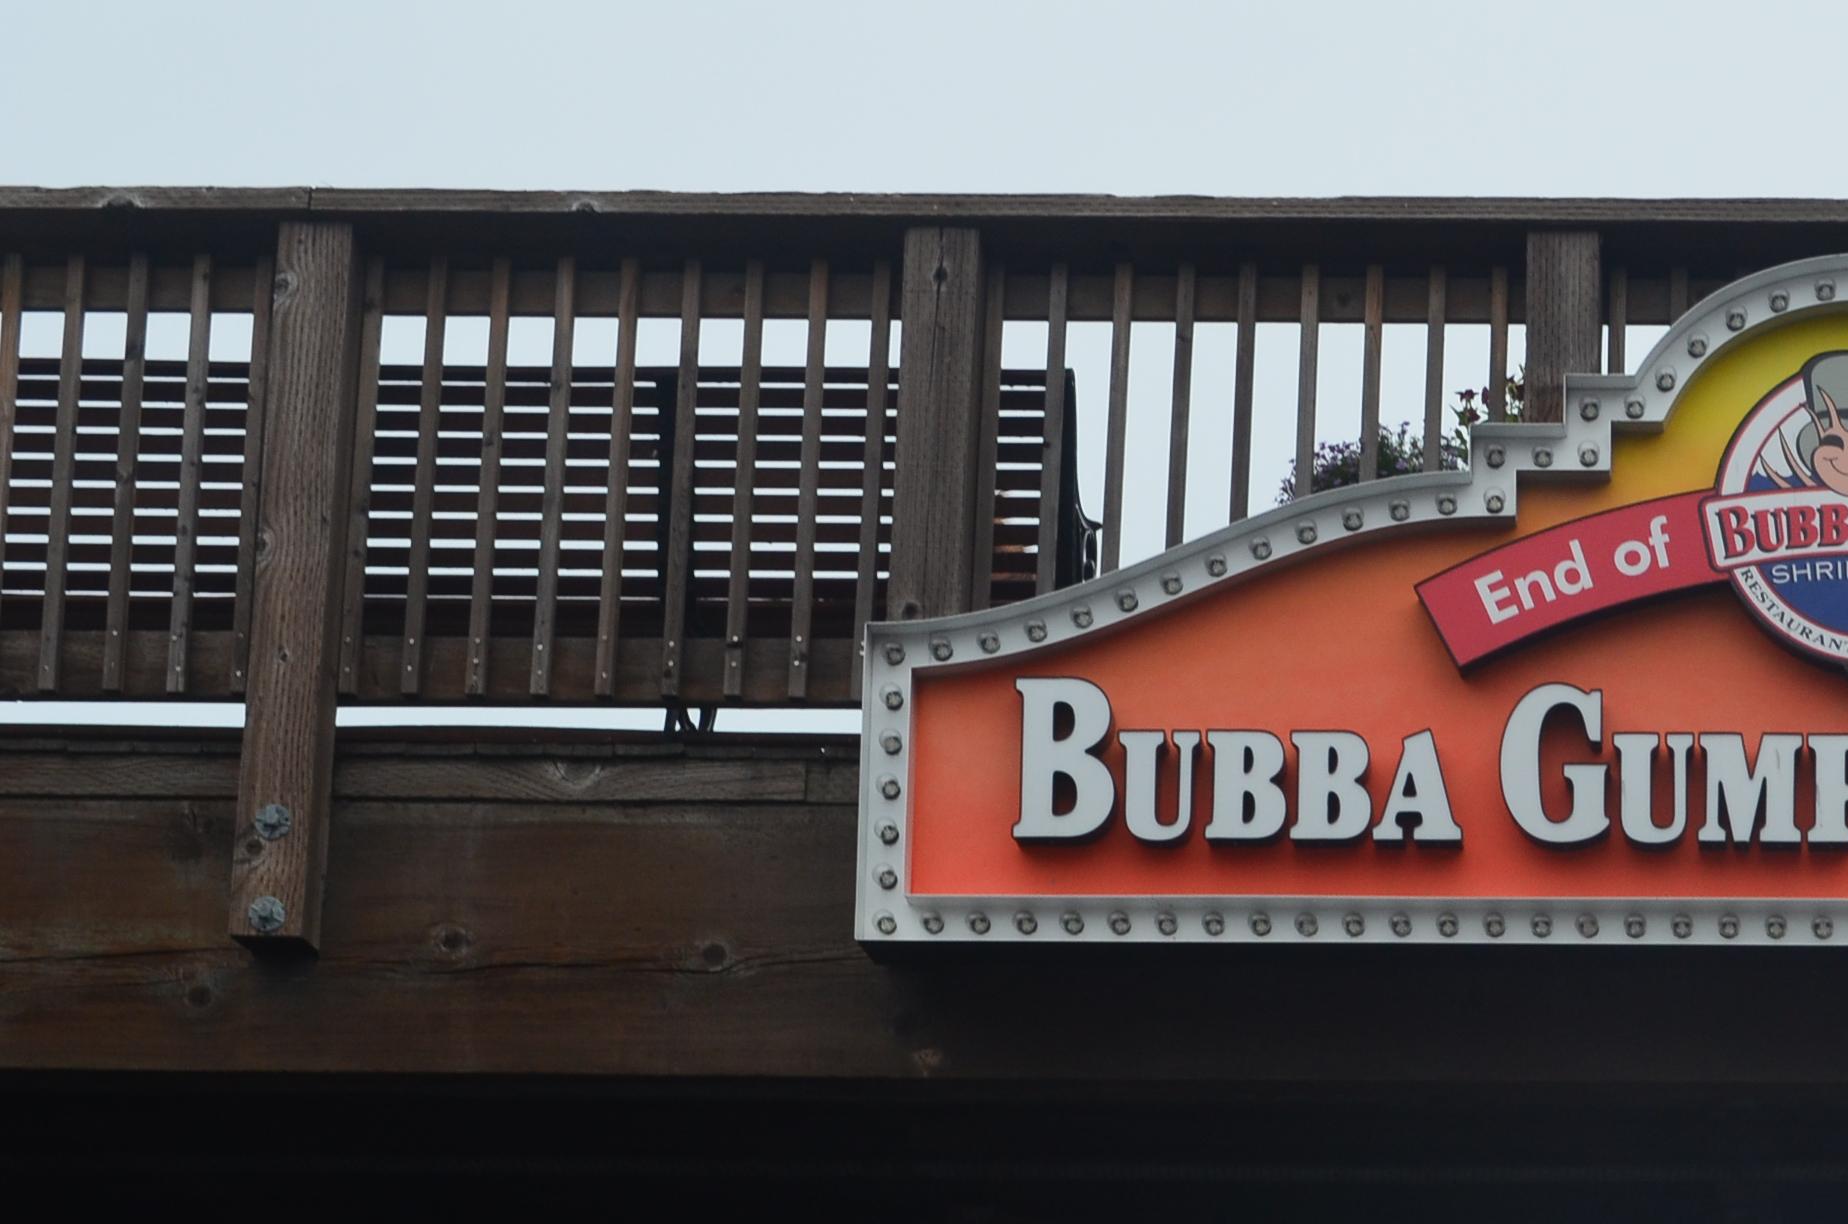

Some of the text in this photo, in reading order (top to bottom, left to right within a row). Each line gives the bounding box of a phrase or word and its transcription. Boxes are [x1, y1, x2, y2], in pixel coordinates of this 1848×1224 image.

[1475, 541, 1595, 625] End
[1612, 512, 1672, 581] of
[1015, 677, 1463, 845] BUBBA
